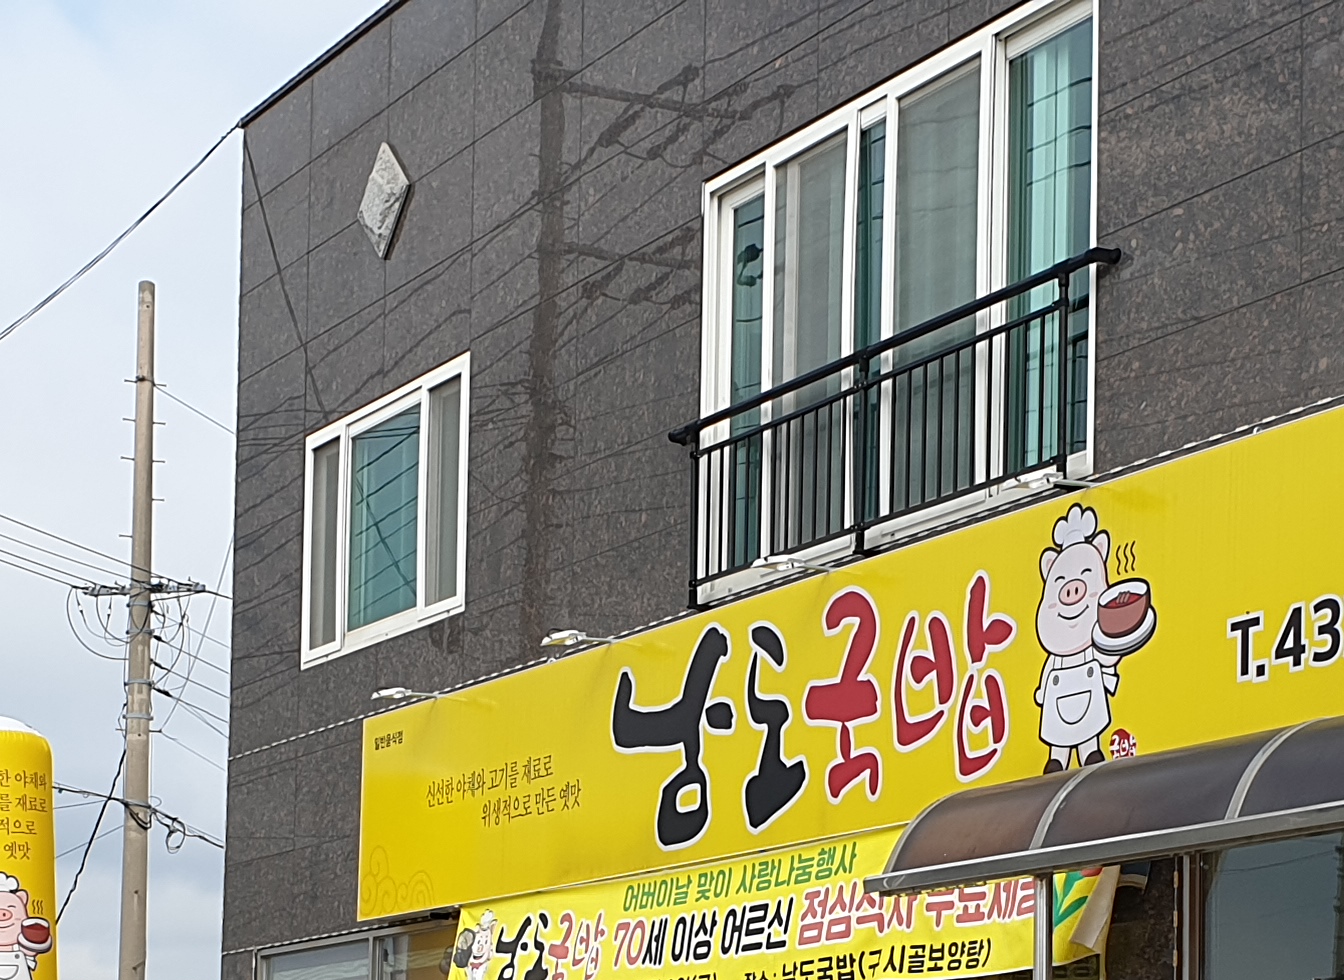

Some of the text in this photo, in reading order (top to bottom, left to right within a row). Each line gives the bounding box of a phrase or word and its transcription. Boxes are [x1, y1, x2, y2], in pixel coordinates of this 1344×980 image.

[612, 575, 1015, 847] 남도국밥
[14, 770, 47, 791] 야채와
[14, 794, 48, 813] 재료로
[425, 754, 554, 808] 신선한 야채와 고기를 재료로
[481, 779, 582, 828] 위생적으로 만든 옛맛
[3, 841, 31, 860] 옛맛
[623, 841, 858, 913] 어버이날 맞이 사랑나눔행사
[613, 915, 669, 969] 70세
[671, 910, 717, 963] 이상
[721, 896, 794, 956] 어르신
